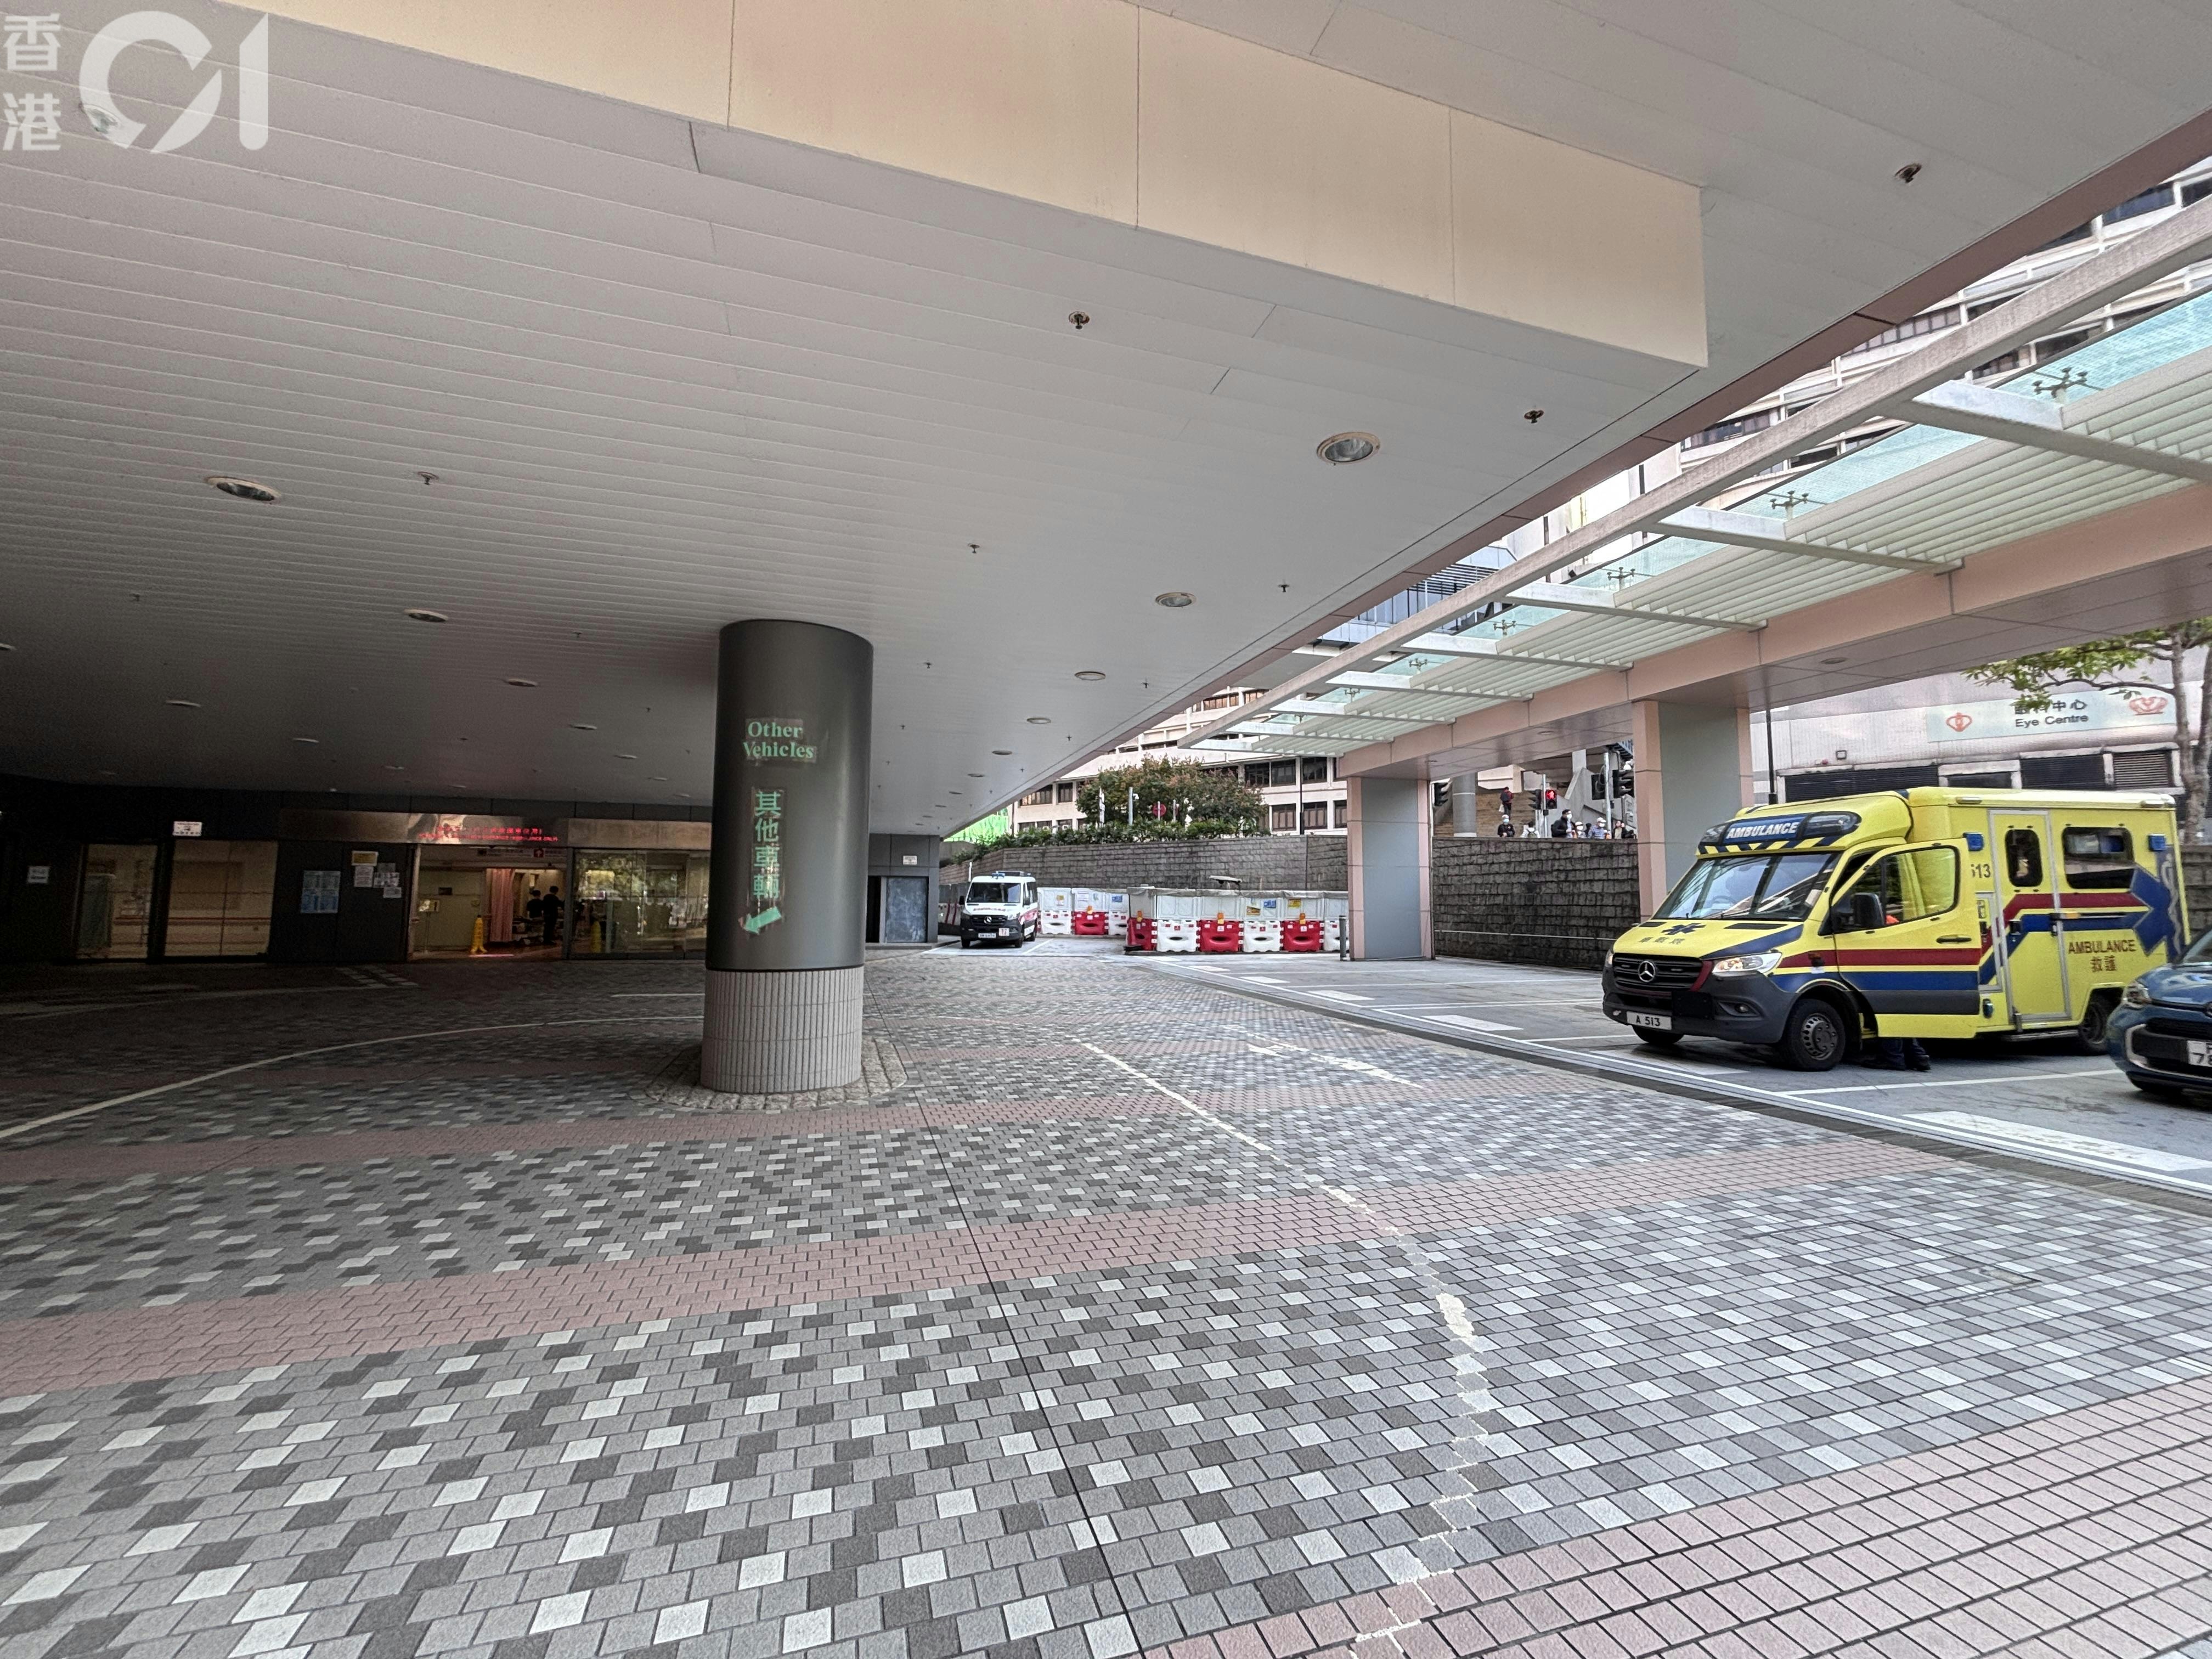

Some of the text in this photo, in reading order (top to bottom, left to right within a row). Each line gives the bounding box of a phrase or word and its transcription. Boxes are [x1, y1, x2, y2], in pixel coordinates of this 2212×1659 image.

[748, 721, 803, 738] Other
[2015, 714, 2089, 729] Eye Centre
[743, 741, 814, 758] Vehicles
[1726, 821, 1800, 839] AMBULANCE
[2068, 939, 2136, 954] AMBULANCE
[1636, 1015, 1661, 1026] A 513
